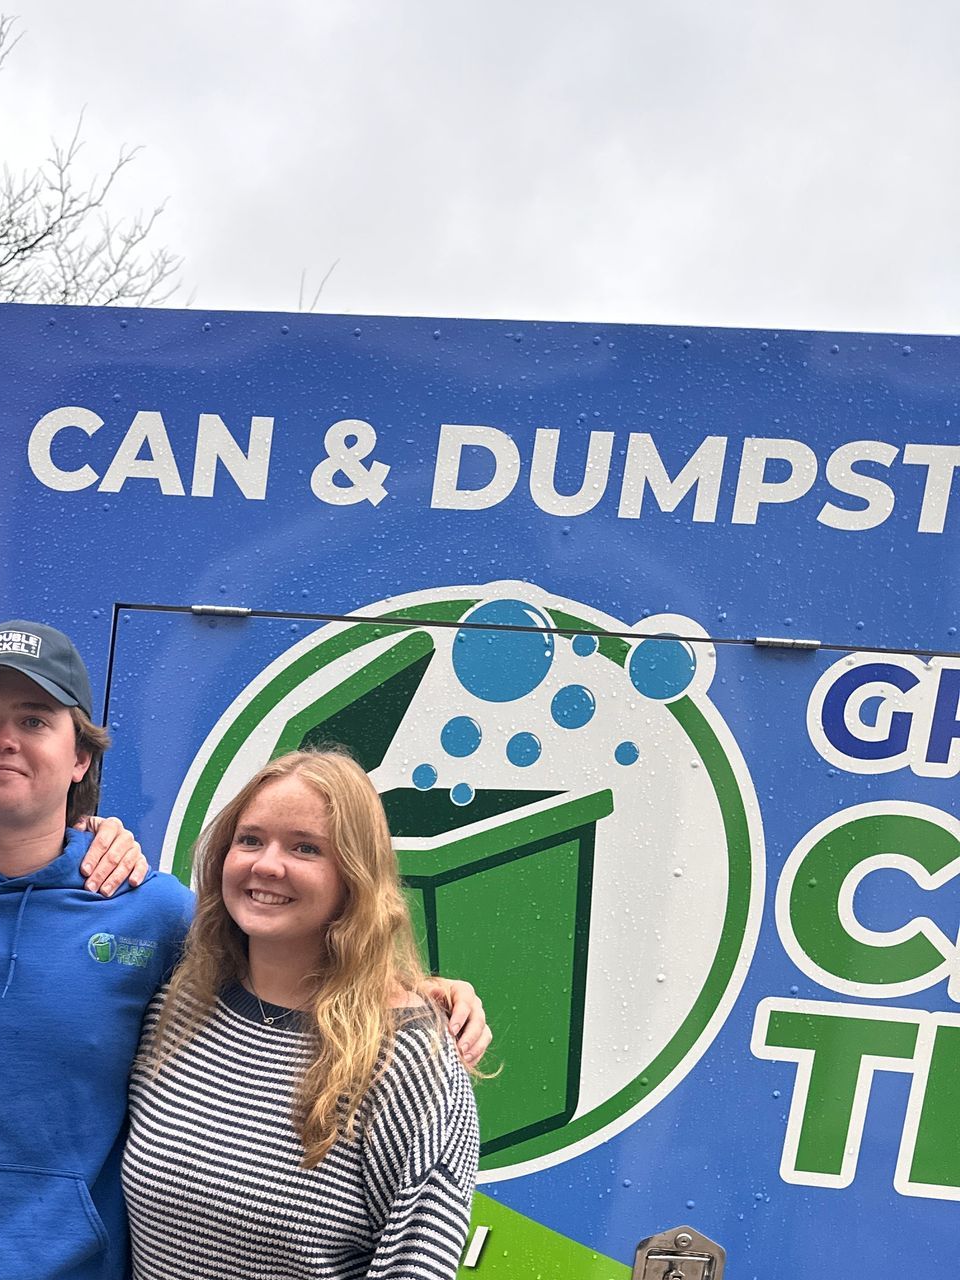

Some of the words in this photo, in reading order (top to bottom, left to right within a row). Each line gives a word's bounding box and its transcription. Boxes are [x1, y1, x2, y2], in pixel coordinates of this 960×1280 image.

[27, 406, 275, 501] CAN
[310, 418, 391, 507] &
[430, 423, 960, 535] DUMPST
